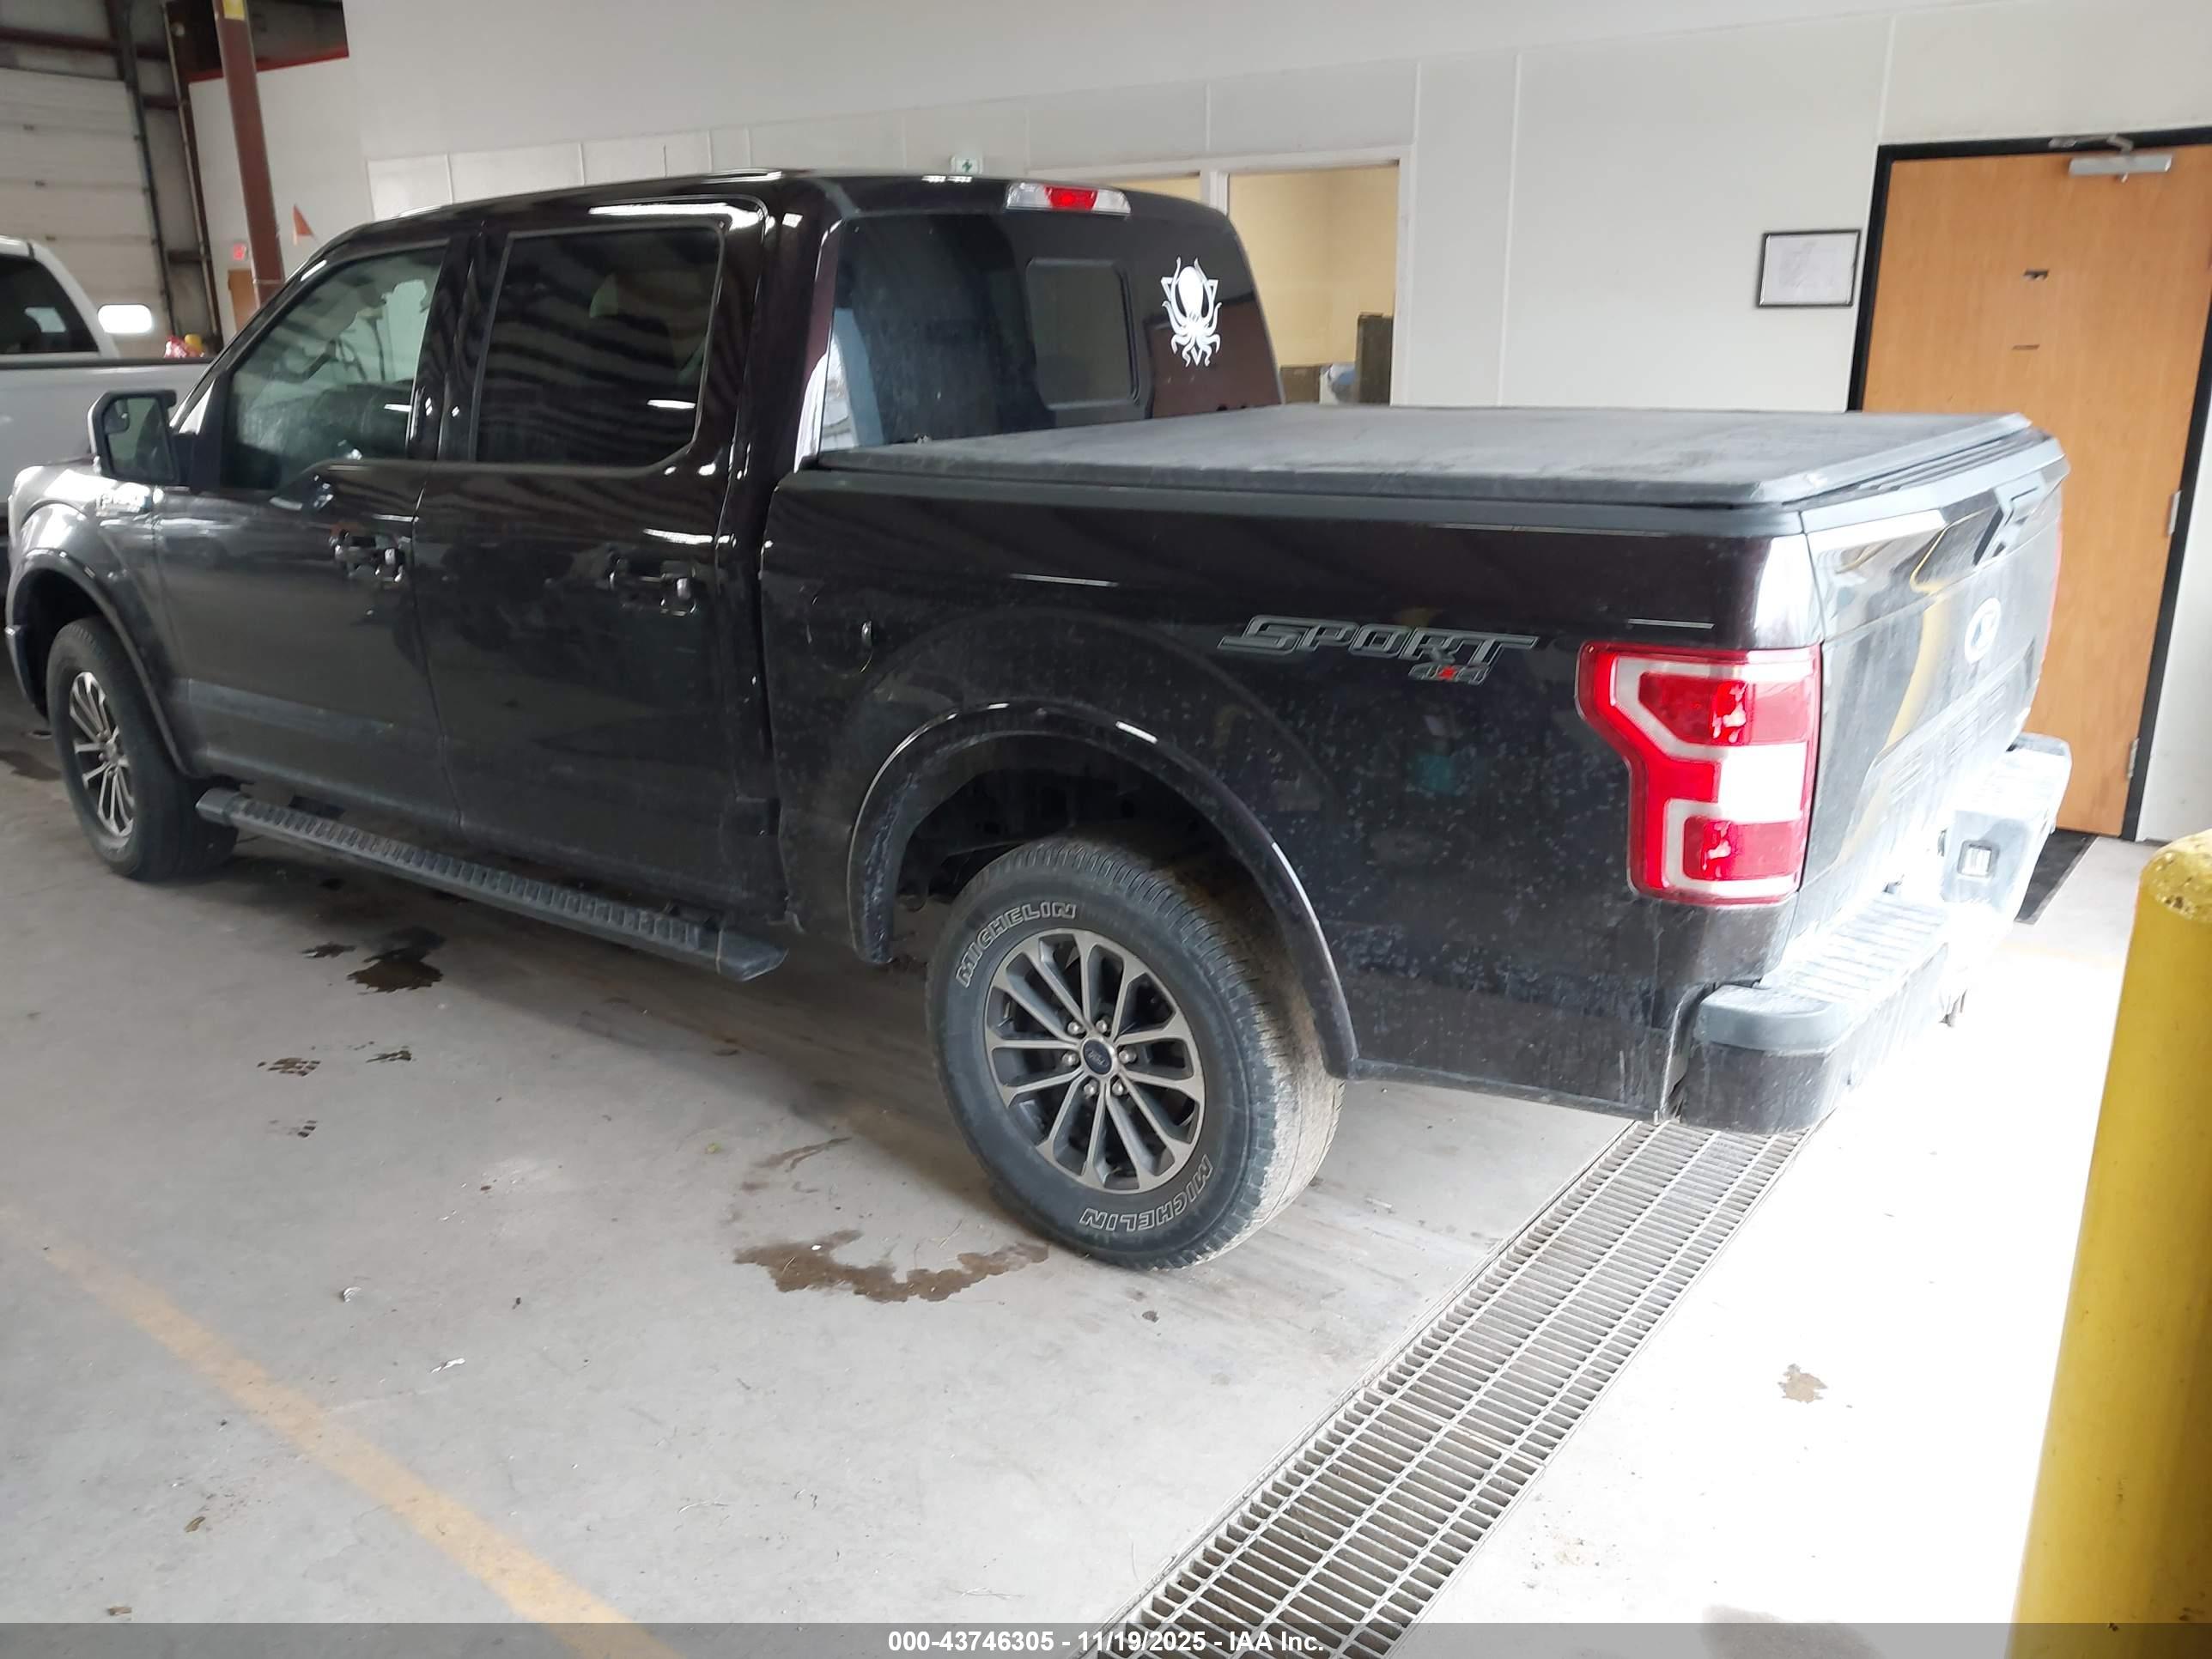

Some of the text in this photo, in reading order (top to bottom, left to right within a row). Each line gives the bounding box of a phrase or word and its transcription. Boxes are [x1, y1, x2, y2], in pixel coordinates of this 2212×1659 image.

[1217, 614, 1540, 665] SPORT
[956, 902, 1076, 988] MICHELIN
[1079, 1154, 1213, 1231] MICHELIN
